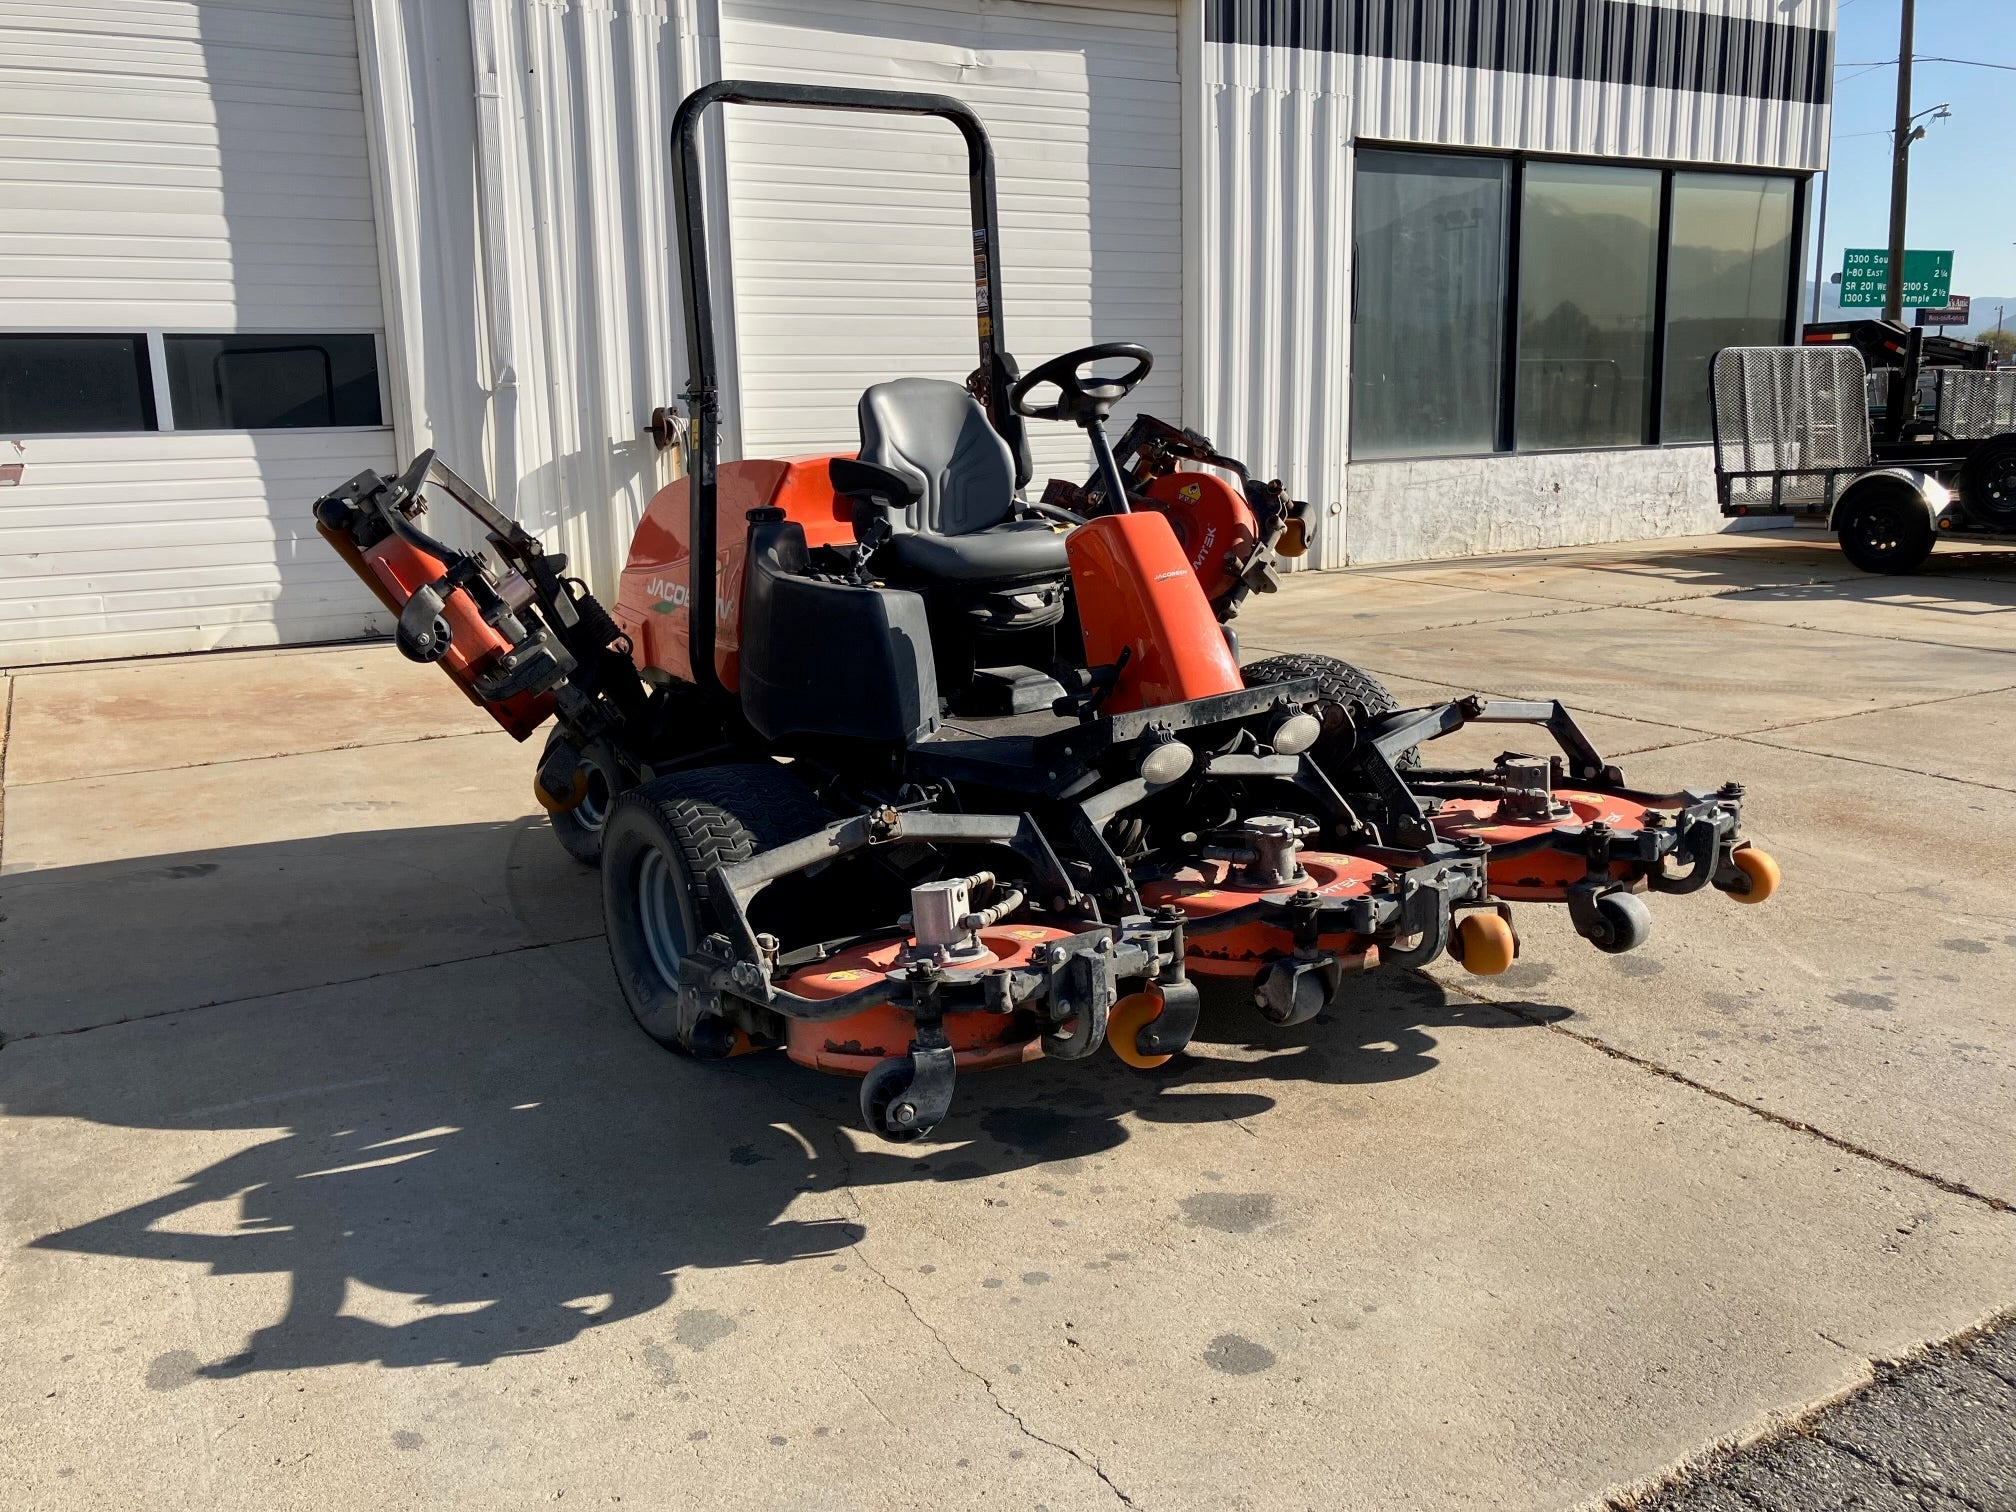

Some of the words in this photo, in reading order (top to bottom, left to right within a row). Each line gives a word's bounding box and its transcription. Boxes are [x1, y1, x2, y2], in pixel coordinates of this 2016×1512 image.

[1848, 254, 1870, 264] 3300
[1933, 269, 1940, 278] 2
[1845, 281, 1857, 291] SR
[1860, 281, 1874, 291] 201
[1902, 282, 1921, 291] 2100
[1923, 282, 1929, 291] S
[1931, 288, 1938, 297] 2
[1844, 293, 1863, 303] 1300
[1864, 293, 1871, 303] S
[1901, 293, 1930, 305] Temple
